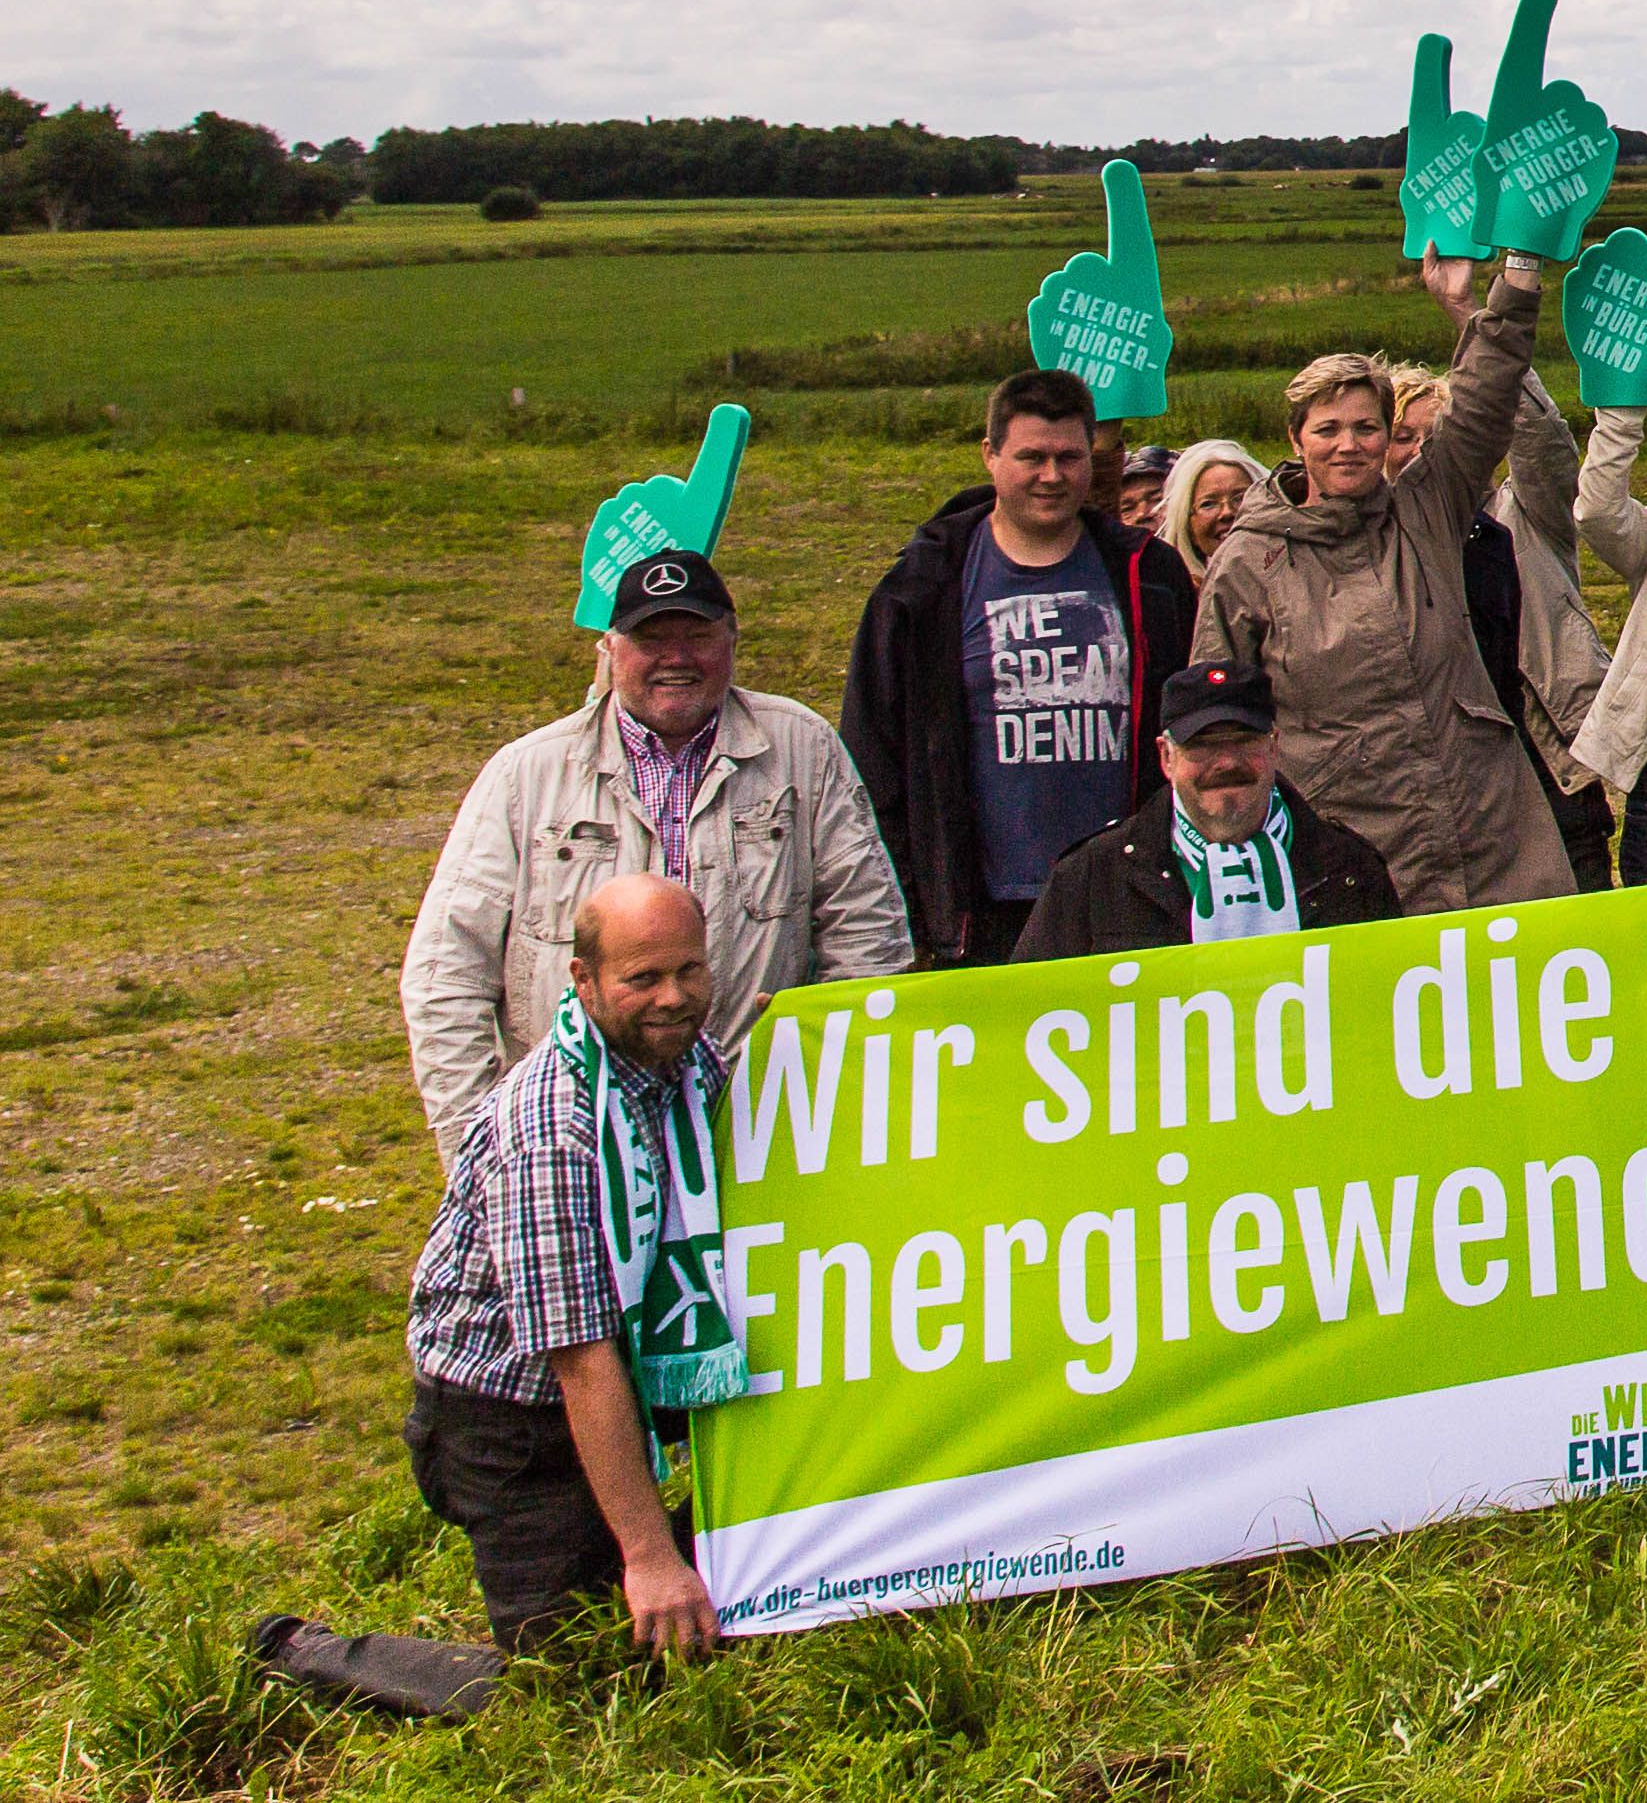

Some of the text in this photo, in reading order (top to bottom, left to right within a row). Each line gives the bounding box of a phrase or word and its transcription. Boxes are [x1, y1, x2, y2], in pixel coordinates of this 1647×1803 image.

[1513, 134, 1609, 191] BÜRGER-
[1528, 173, 1588, 218] HAND
[1064, 322, 1159, 371] BÜRGER-
[1582, 328, 1642, 373] HAND
[589, 556, 622, 602] HAN
[985, 593, 1062, 641] WE
[991, 645, 1130, 705] SPEAK
[995, 709, 1130, 764] DENIM
[731, 916, 1614, 1184] Wir sind die
